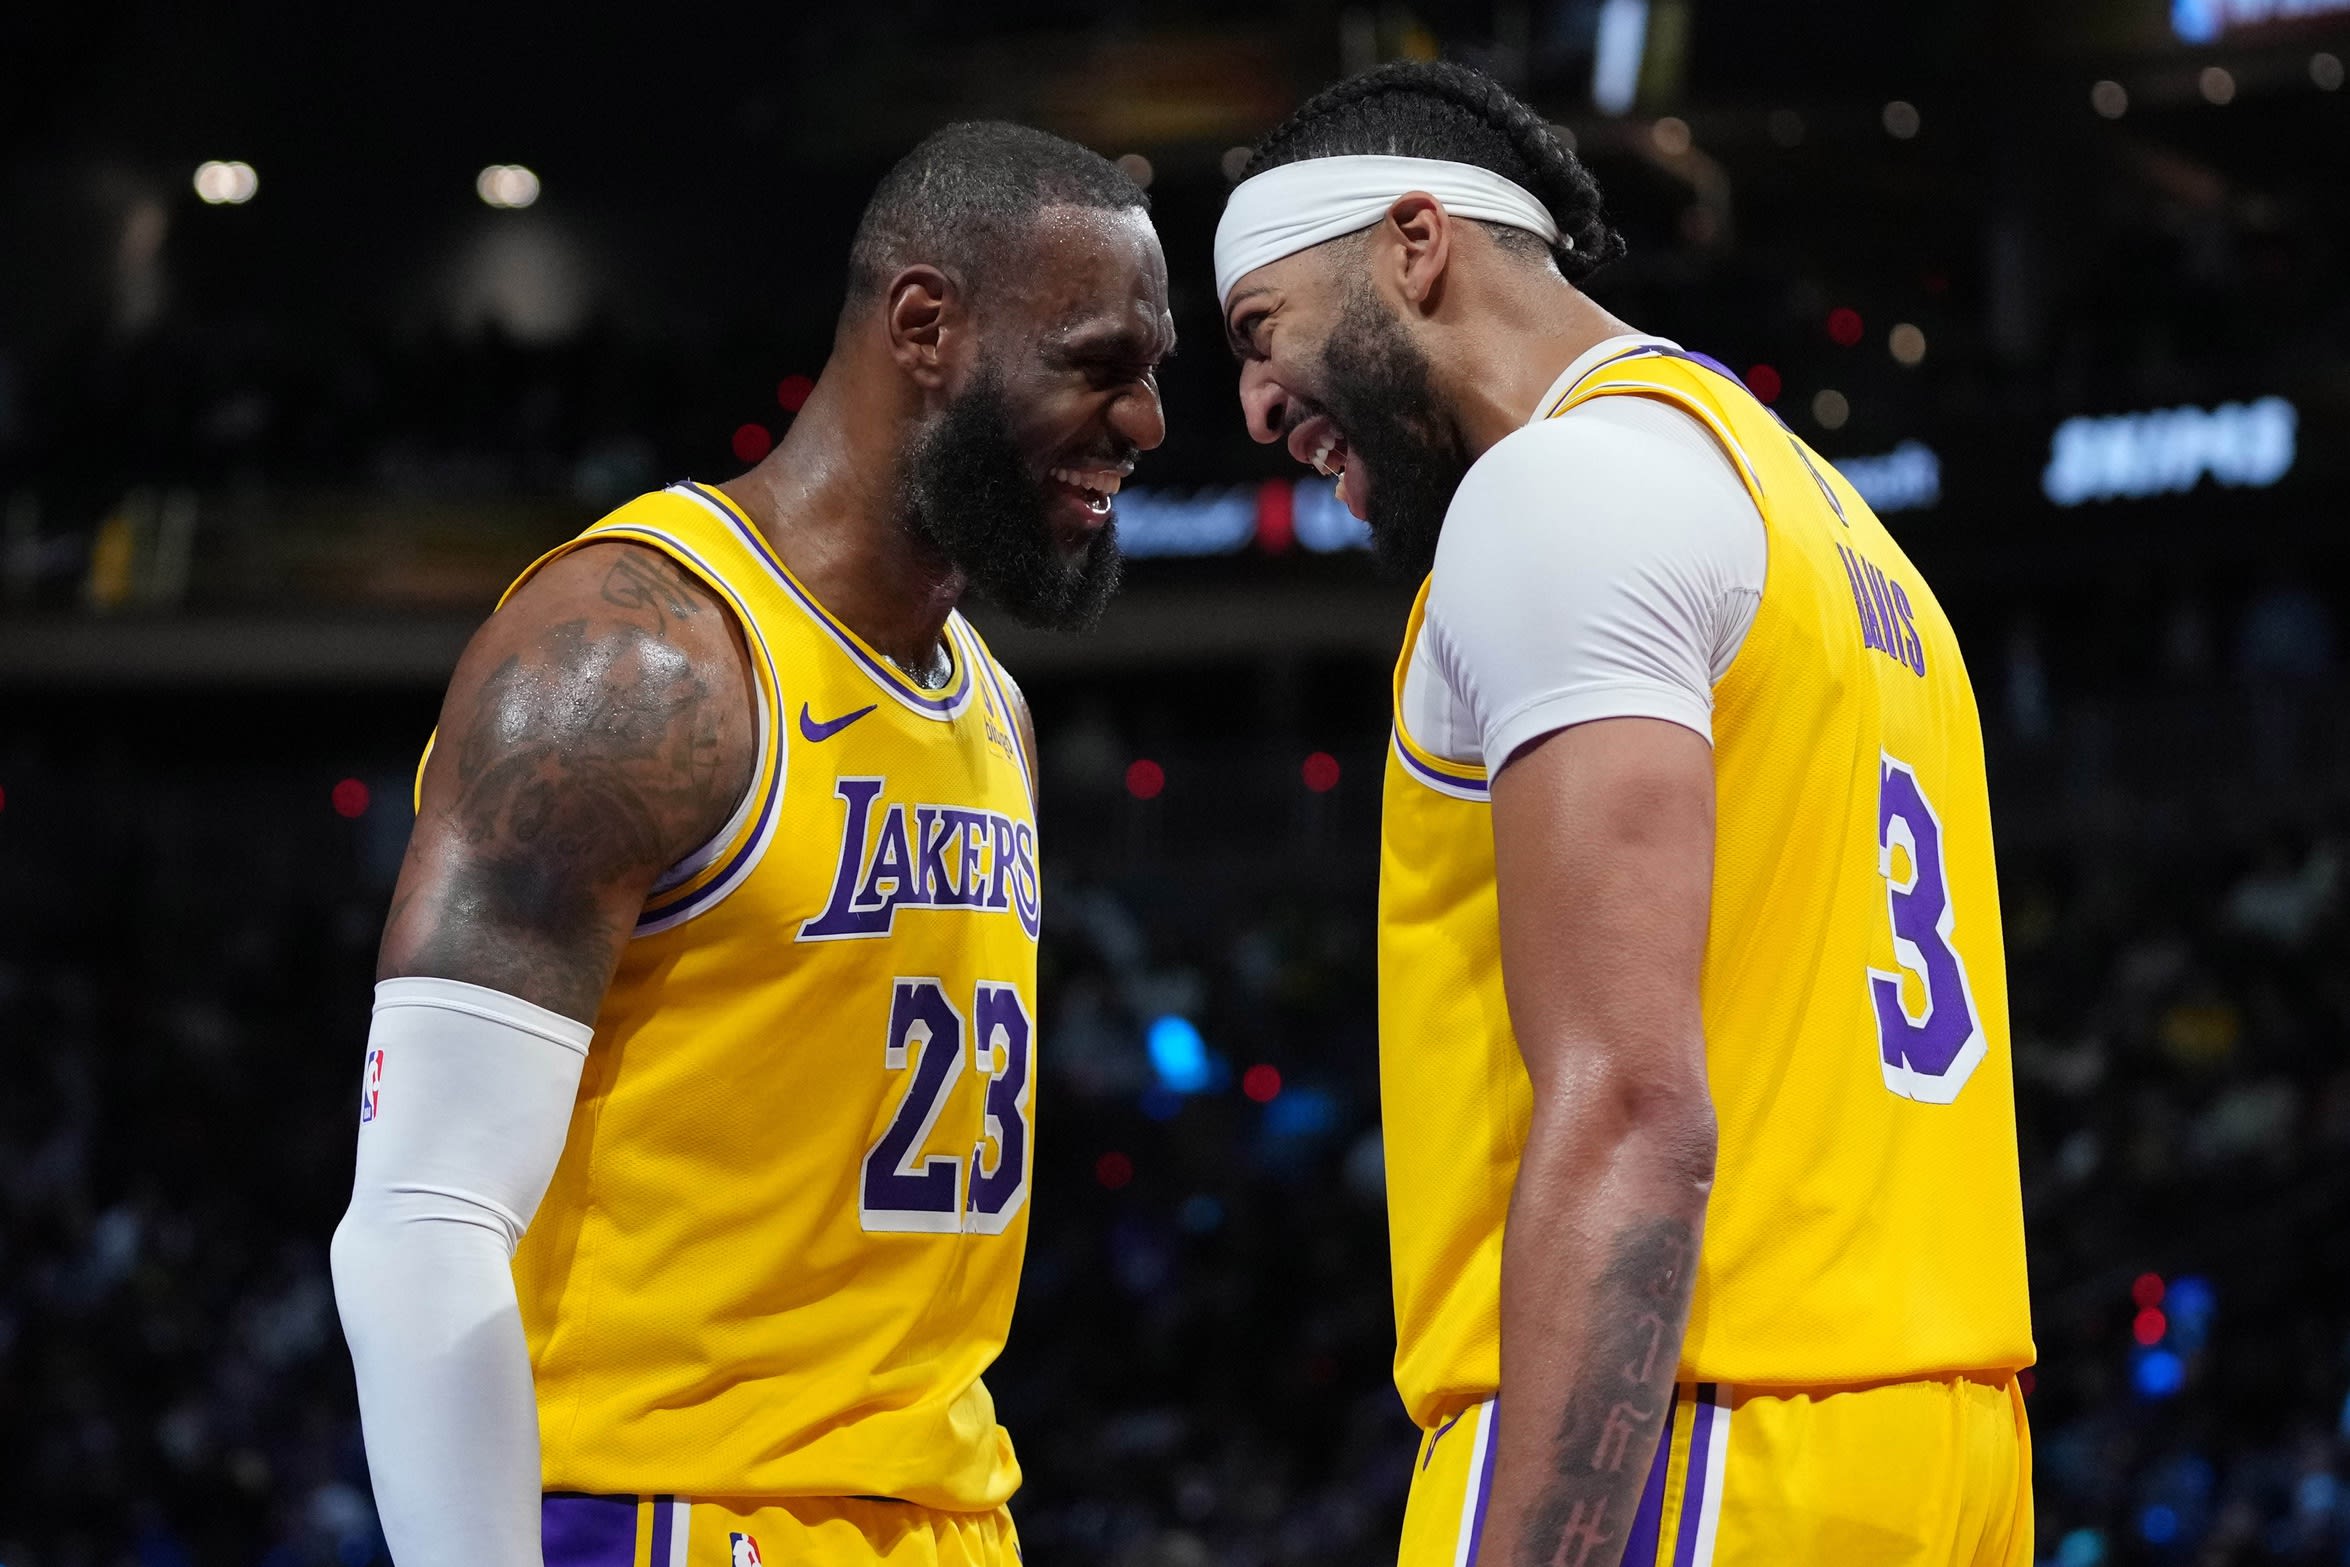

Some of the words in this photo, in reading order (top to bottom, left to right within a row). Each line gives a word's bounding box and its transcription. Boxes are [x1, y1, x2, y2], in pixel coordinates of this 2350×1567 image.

[1836, 542, 1925, 678] DAVIS
[794, 776, 1041, 942] LAKERS
[1866, 745, 1988, 1105] 3
[859, 976, 1032, 1234] 23
